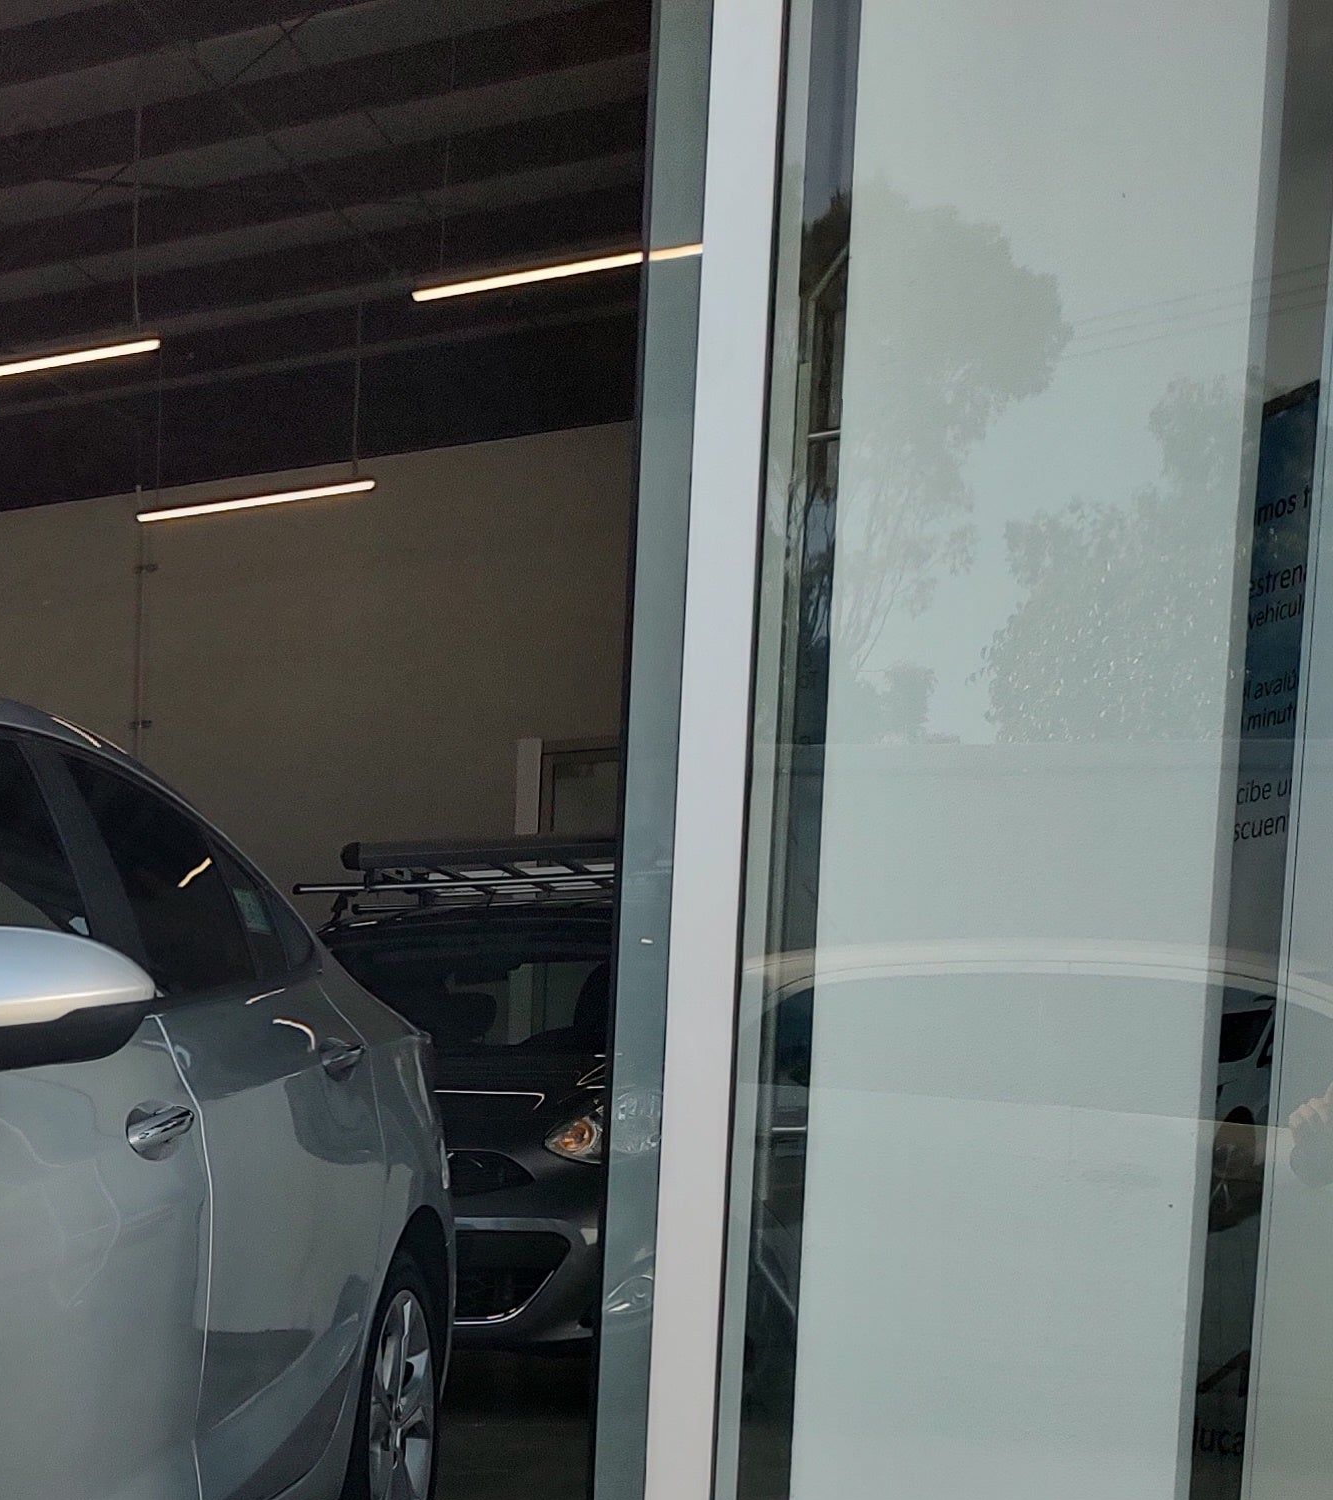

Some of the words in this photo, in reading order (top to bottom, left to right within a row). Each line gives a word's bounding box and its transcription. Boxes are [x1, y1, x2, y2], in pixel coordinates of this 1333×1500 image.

[1255, 494, 1297, 526] mos
[1249, 564, 1307, 599] estren
[1248, 594, 1305, 629] vehícul
[1254, 669, 1299, 700] avalú
[1234, 813, 1289, 841] scuen
